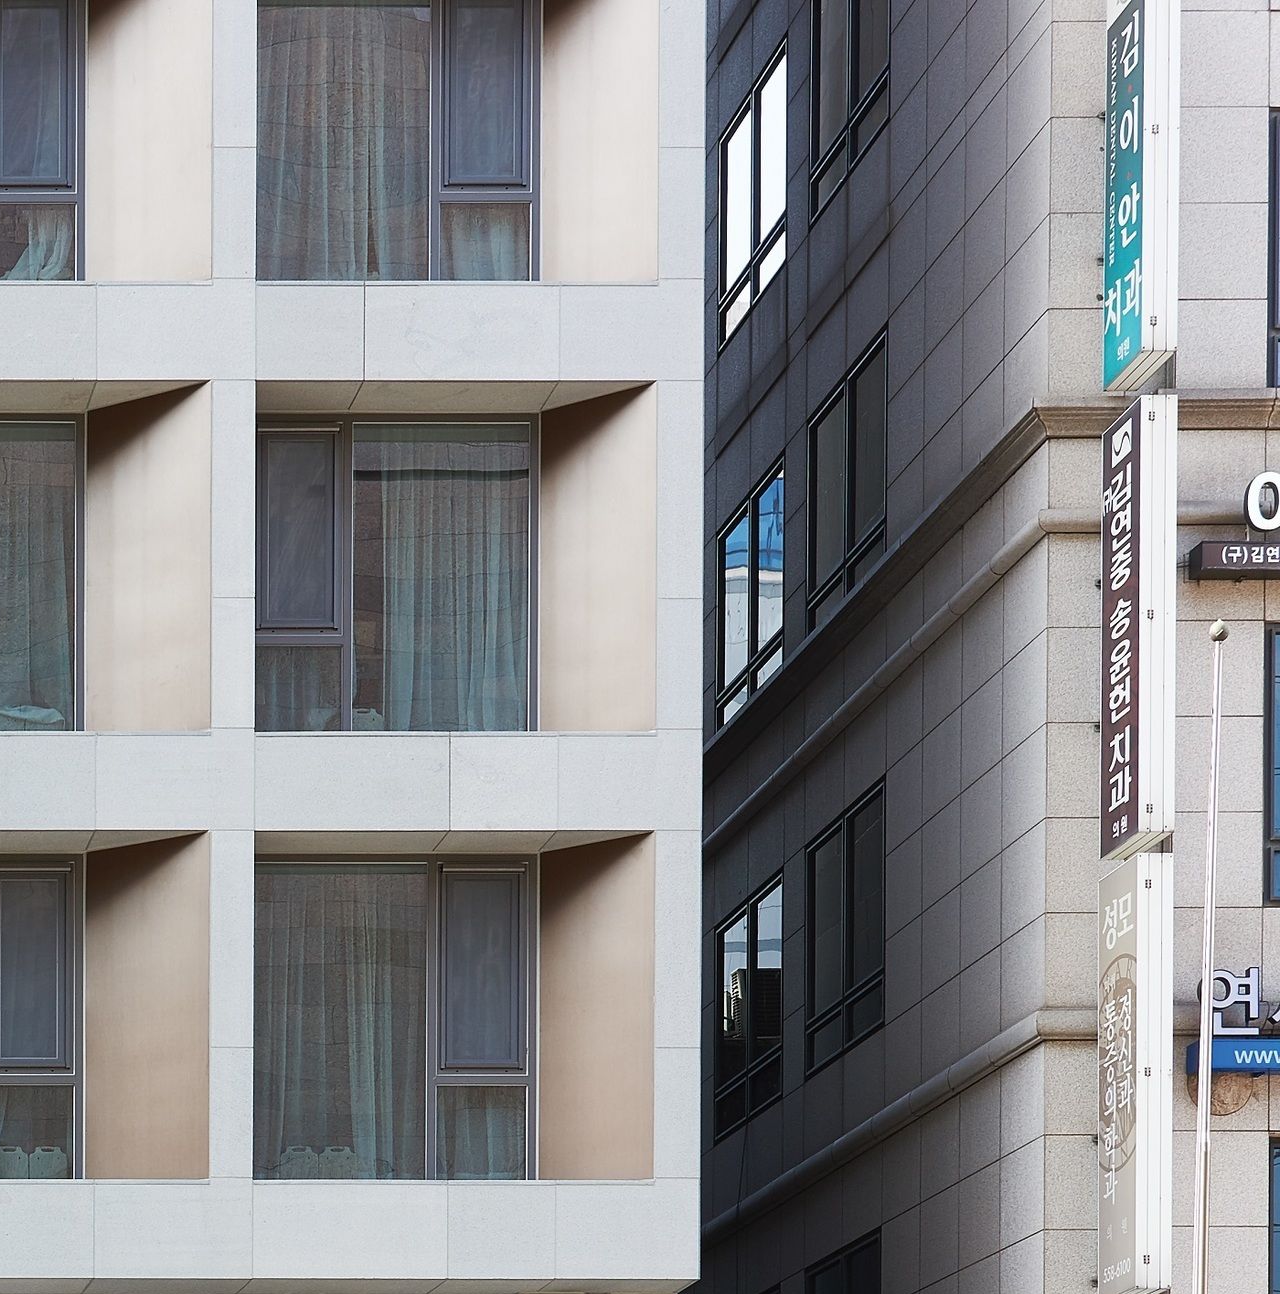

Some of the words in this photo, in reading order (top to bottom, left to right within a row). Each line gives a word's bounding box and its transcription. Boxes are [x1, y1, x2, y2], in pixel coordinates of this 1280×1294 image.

[1105, 258, 1142, 336] 치과
[1109, 461, 1132, 591] 김연중
[1109, 598, 1132, 724] 송윤헌
[1108, 724, 1132, 812] 치과
[1119, 988, 1133, 1115] 정신과
[1103, 1257, 1131, 1283] 558-6100
